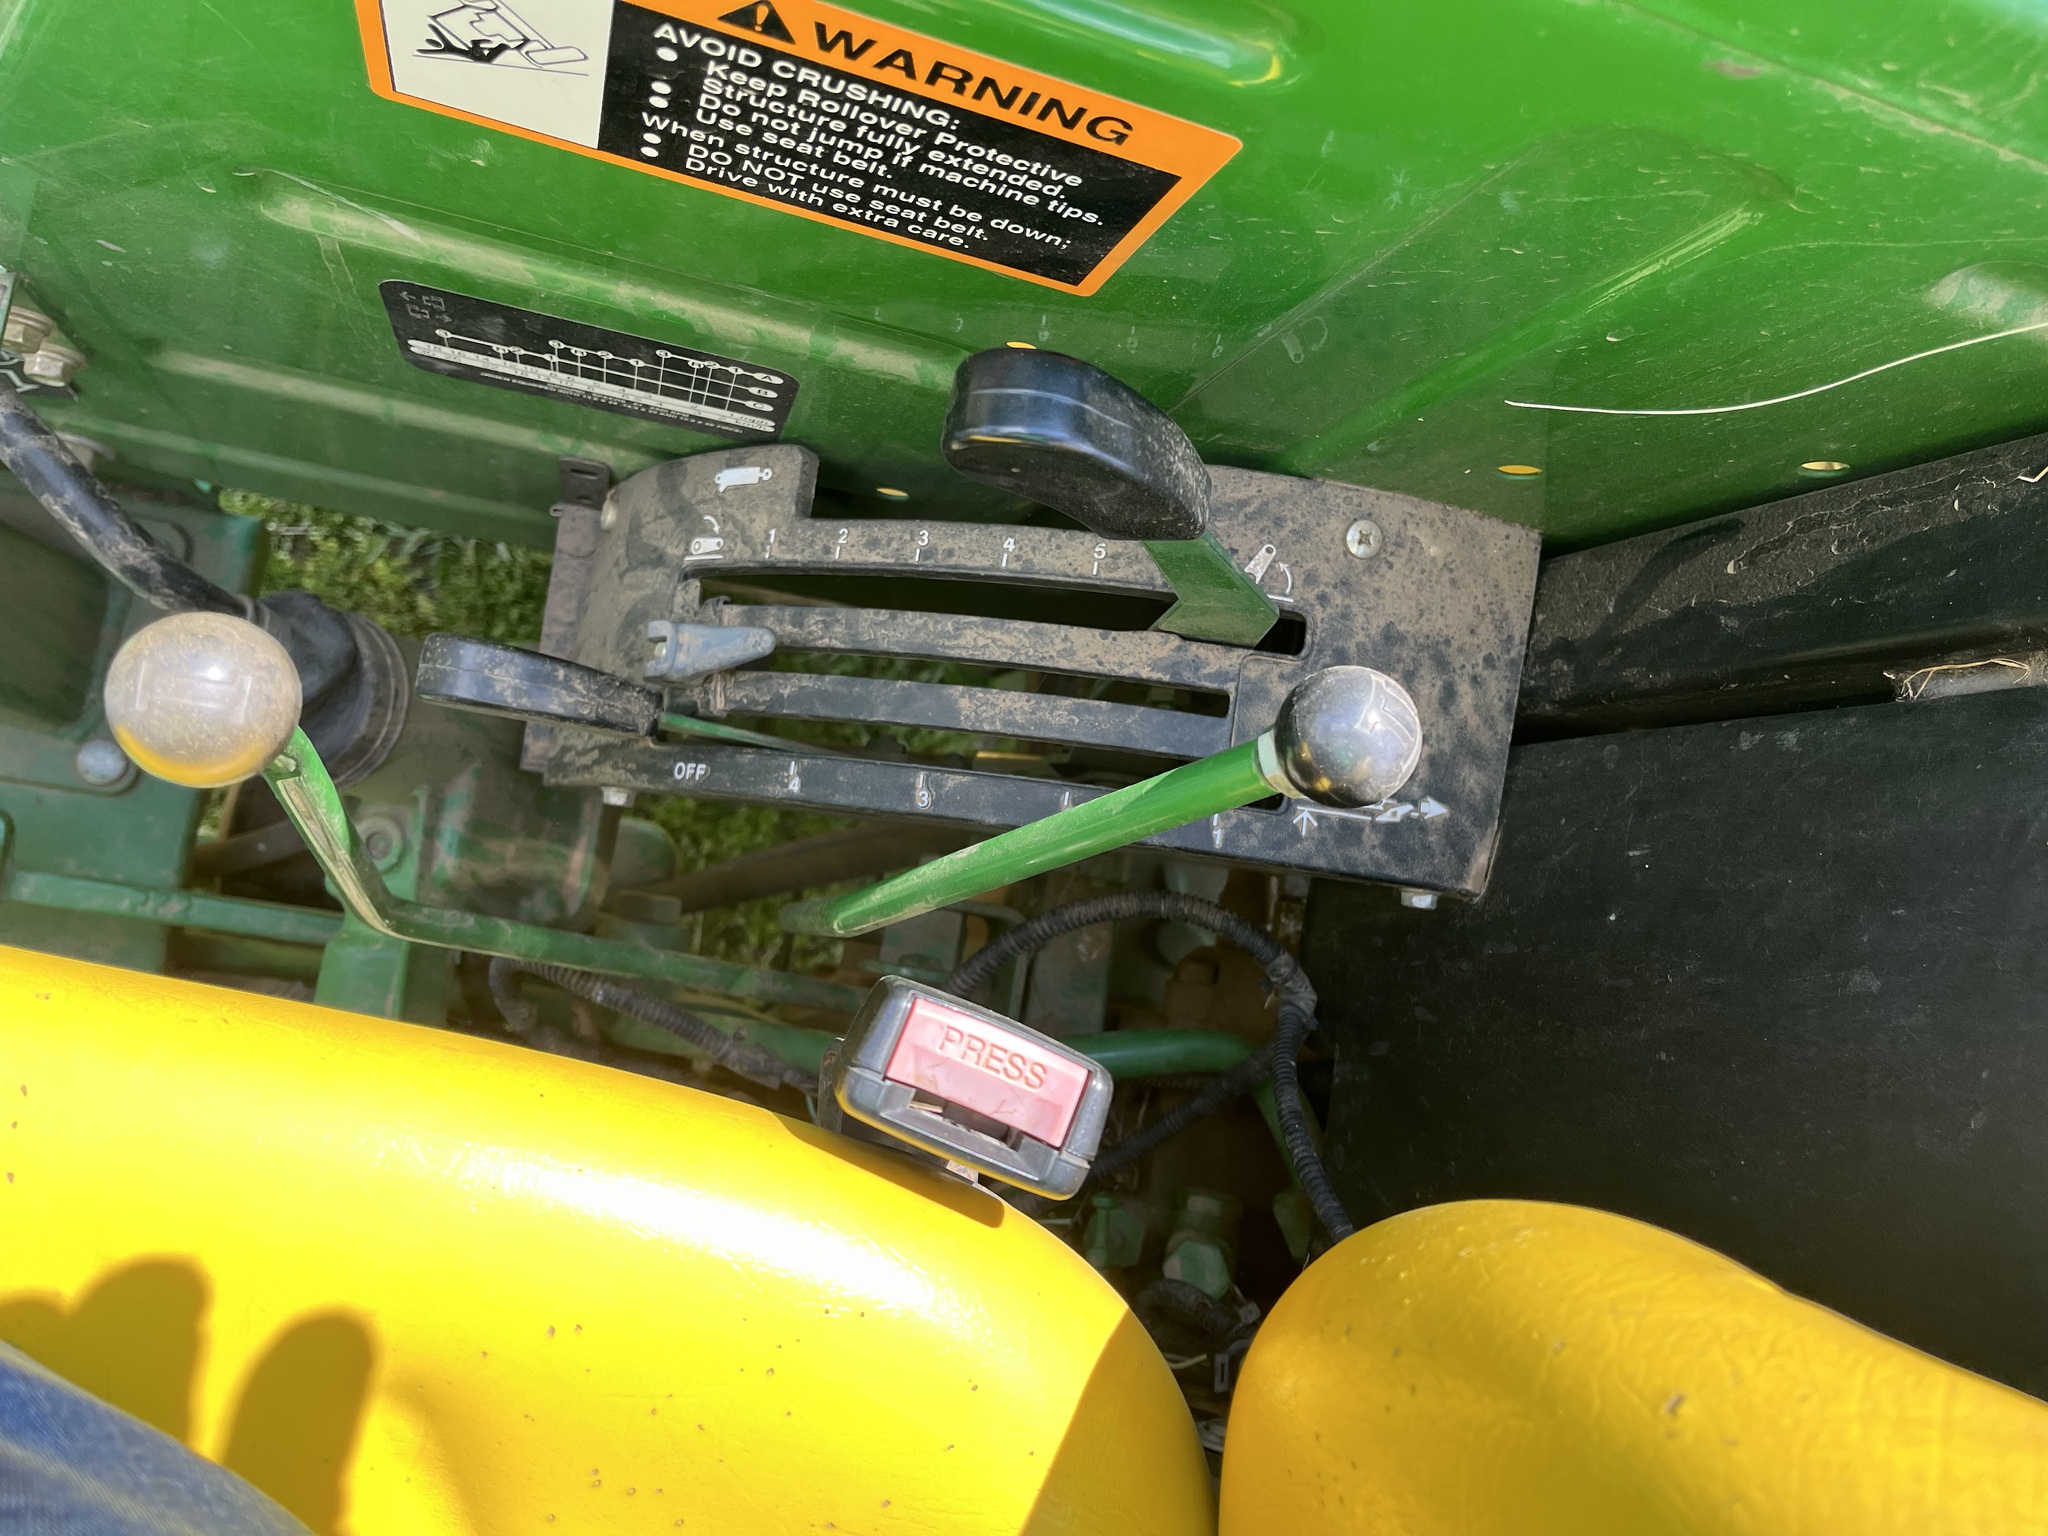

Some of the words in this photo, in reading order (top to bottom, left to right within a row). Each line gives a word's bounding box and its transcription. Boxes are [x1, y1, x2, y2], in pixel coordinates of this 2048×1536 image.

[654, 23, 763, 69] AVOID
[771, 60, 961, 131] CRUSHING:
[814, 21, 1134, 146] WARNING
[696, 109, 753, 137] Use
[762, 132, 826, 160] seat
[833, 151, 894, 180] belt.
[699, 93, 742, 117] Do
[751, 110, 801, 136] not
[807, 127, 884, 161] jump
[891, 152, 914, 168] if
[918, 164, 1040, 207] machine
[1047, 197, 1104, 227] tips.
[702, 78, 848, 133] Structure
[856, 126, 921, 156] fully
[927, 150, 1067, 200] extended.
[707, 61, 788, 98] Keep
[797, 89, 927, 138] Rollover
[934, 132, 1083, 188] Protective
[641, 112, 725, 148] When
[734, 143, 865, 189] structure
[873, 183, 943, 212] must
[949, 205, 983, 223] be
[990, 218, 1072, 251] down;
[685, 158, 758, 188] Drive
[768, 183, 824, 207] with
[832, 202, 899, 229] extra
[907, 225, 970, 250] care.
[688, 145, 733, 166] DO
[742, 160, 805, 187] NOT
[812, 183, 862, 204] use
[868, 199, 935, 225] seat
[933, 215, 989, 241] belt.
[768, 528, 776, 543] 1
[838, 528, 849, 544] 2
[917, 530, 929, 546] 3
[1003, 537, 1015, 552] 4
[1093, 543, 1106, 559] 5
[674, 762, 706, 780] OFF
[788, 776, 800, 793] 4
[917, 790, 929, 807] 3
[937, 1025, 1048, 1091] PRESS
